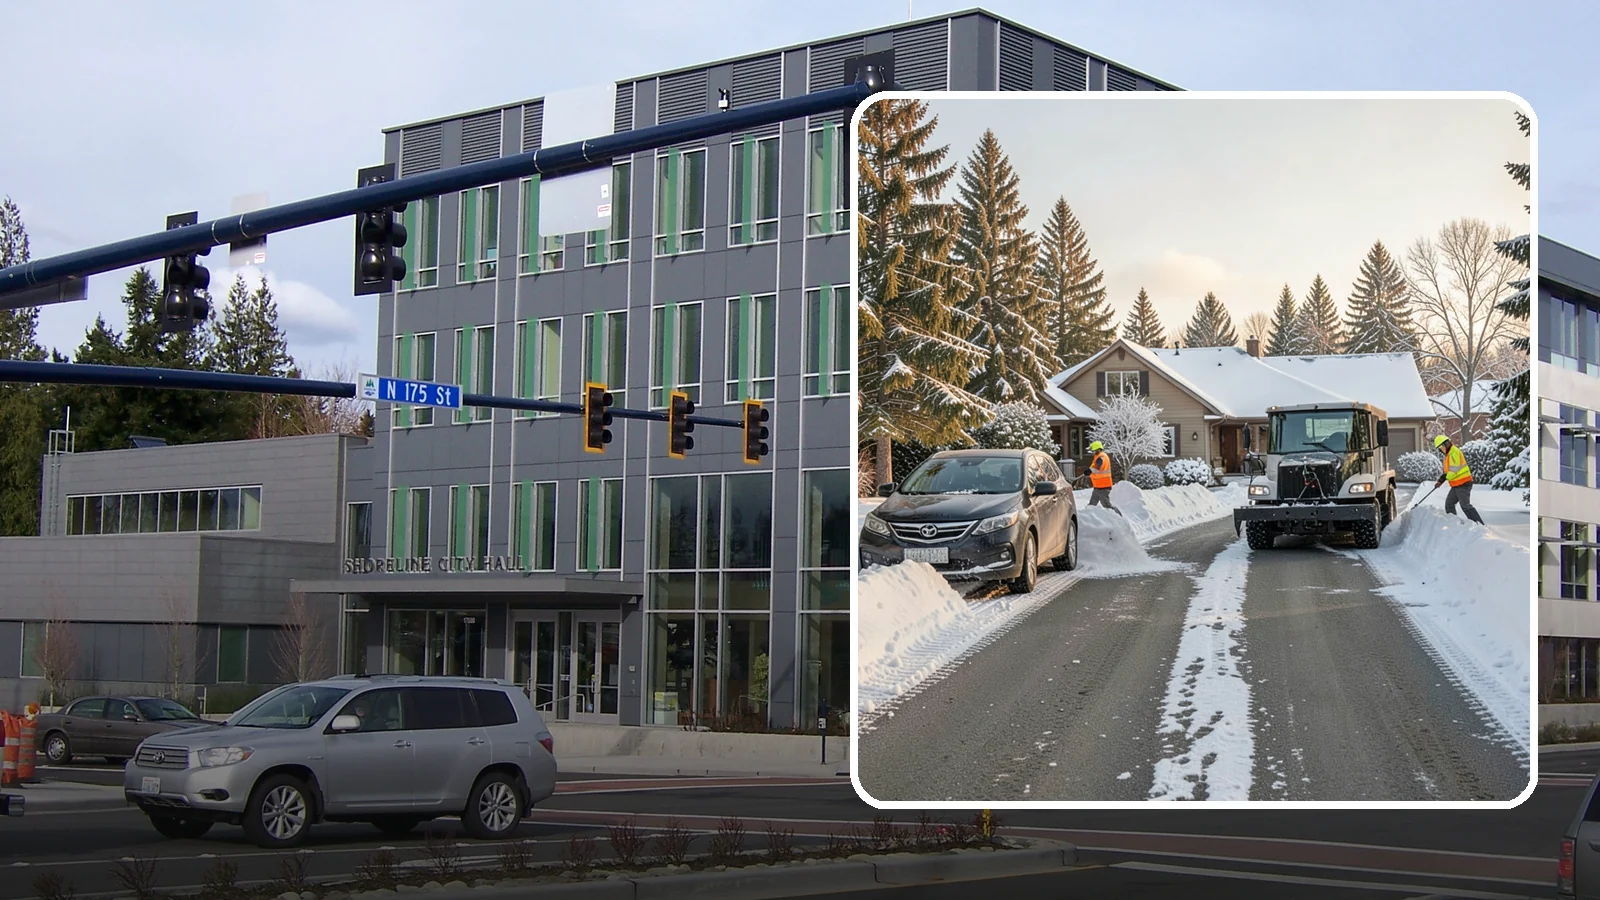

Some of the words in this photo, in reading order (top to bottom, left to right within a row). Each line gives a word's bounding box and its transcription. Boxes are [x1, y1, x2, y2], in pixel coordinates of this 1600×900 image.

[387, 380, 396, 400] N
[405, 382, 427, 403] 175
[436, 386, 451, 405] St
[344, 557, 431, 573] SHORELINE
[438, 556, 475, 572] CITY
[484, 555, 525, 571] HALL
